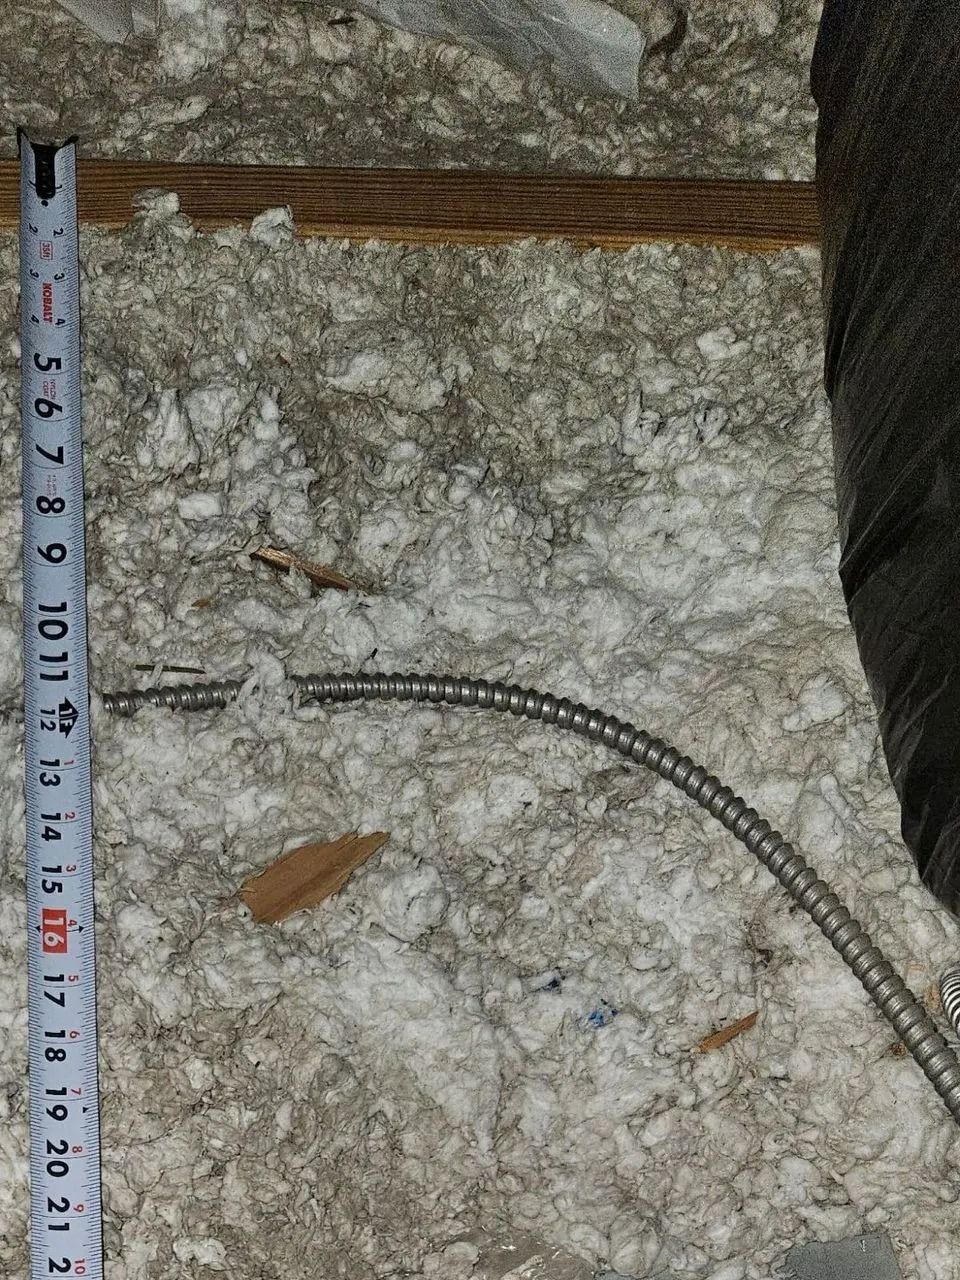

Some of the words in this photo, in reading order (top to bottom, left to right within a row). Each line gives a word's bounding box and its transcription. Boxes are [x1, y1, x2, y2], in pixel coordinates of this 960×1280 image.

[29, 223, 38, 233] 2
[53, 227, 63, 236] 2
[29, 269, 39, 278] 3
[54, 272, 65, 280] 3
[42, 282, 53, 324] KOBALT
[31, 315, 39, 324] 4
[55, 318, 65, 326] 4
[33, 353, 62, 371] 5
[34, 397, 62, 418] 6
[36, 444, 64, 464] 7
[36, 496, 65, 514] 8
[37, 543, 67, 563] 9
[38, 602, 68, 640] 10
[39, 652, 68, 681] 11
[40, 709, 56, 731] 12
[39, 759, 61, 786] 13
[65, 812, 75, 820] 2
[41, 812, 62, 842] 14
[42, 865, 63, 894] 15
[44, 917, 65, 947] 16
[44, 974, 65, 1008] 17
[70, 1030, 80, 1039] 6
[45, 1030, 66, 1062] 18
[45, 1087, 68, 1121] 19
[46, 1139, 69, 1177] 20
[47, 1196, 70, 1231] 21
[73, 1204, 84, 1212] 9
[74, 1258, 86, 1274] 10
